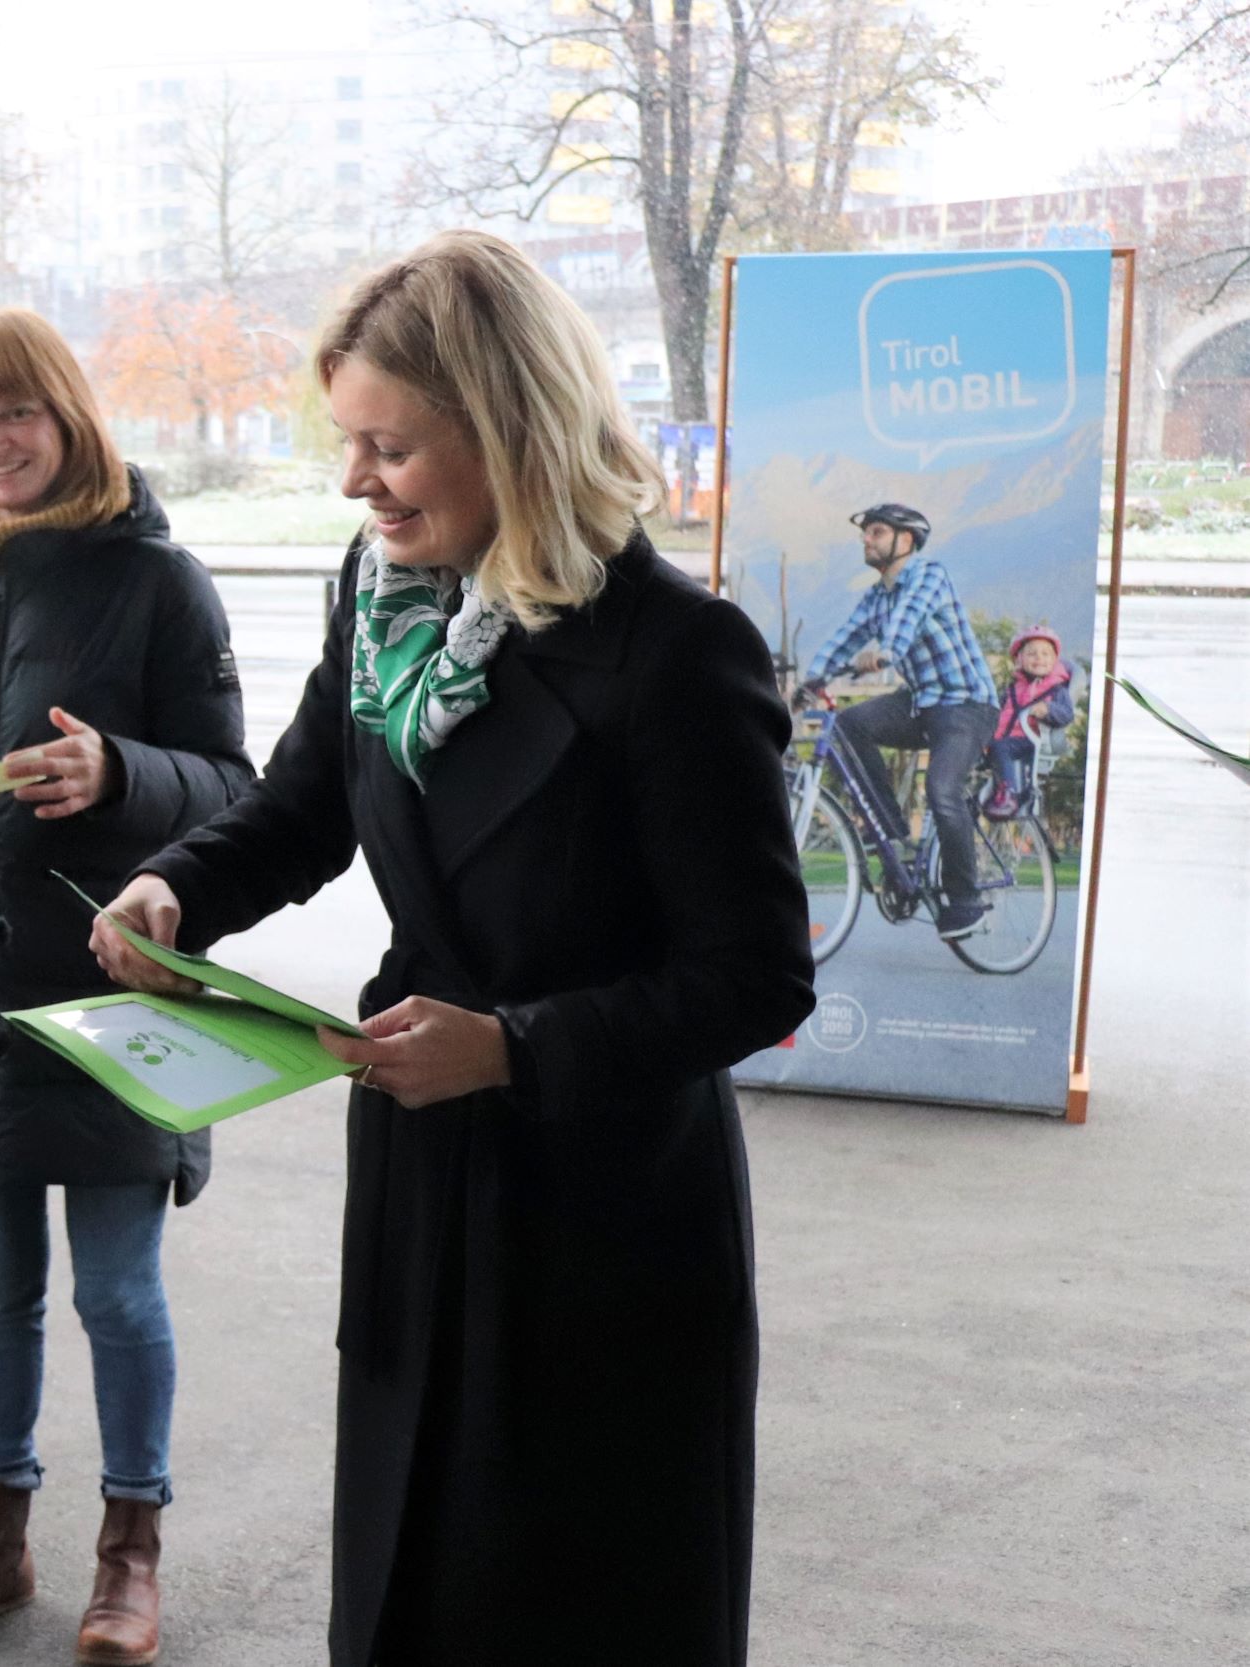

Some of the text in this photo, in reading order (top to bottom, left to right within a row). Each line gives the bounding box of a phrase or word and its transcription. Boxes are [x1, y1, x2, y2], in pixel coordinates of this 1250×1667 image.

[881, 335, 962, 371] Tirol
[889, 370, 1038, 416] MOBIL
[820, 1005, 854, 1020] TIROL
